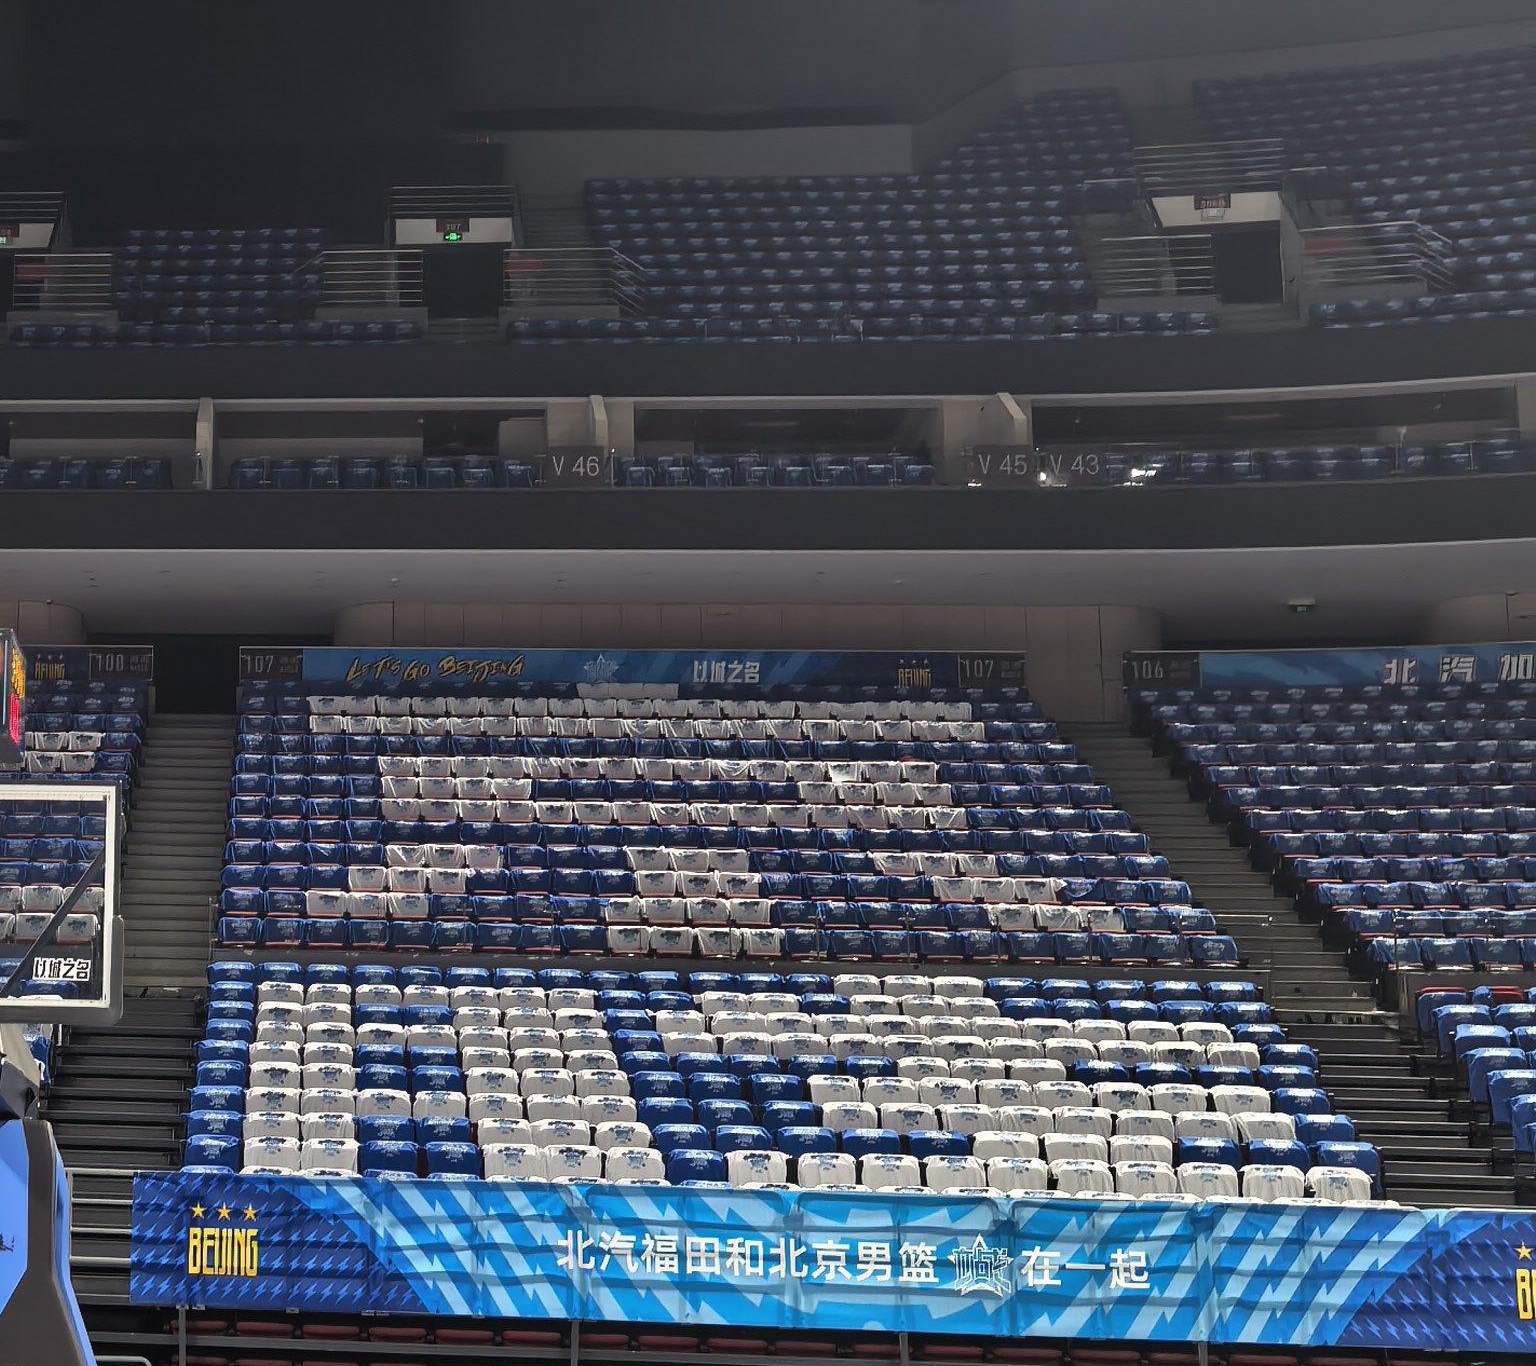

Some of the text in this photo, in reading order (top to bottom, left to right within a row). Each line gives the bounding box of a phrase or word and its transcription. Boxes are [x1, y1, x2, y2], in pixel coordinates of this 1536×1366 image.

[552, 455, 600, 477] V 46
[977, 453, 1028, 475] V 45
[1047, 453, 1100, 475] V 43
[246, 655, 275, 675] 107
[403, 660, 430, 681] GO
[693, 659, 761, 684] 以城之名
[964, 658, 994, 679] 107
[1132, 659, 1164, 680] 106
[33, 958, 89, 980] 以城之名
[188, 1227, 259, 1277] BEIJING
